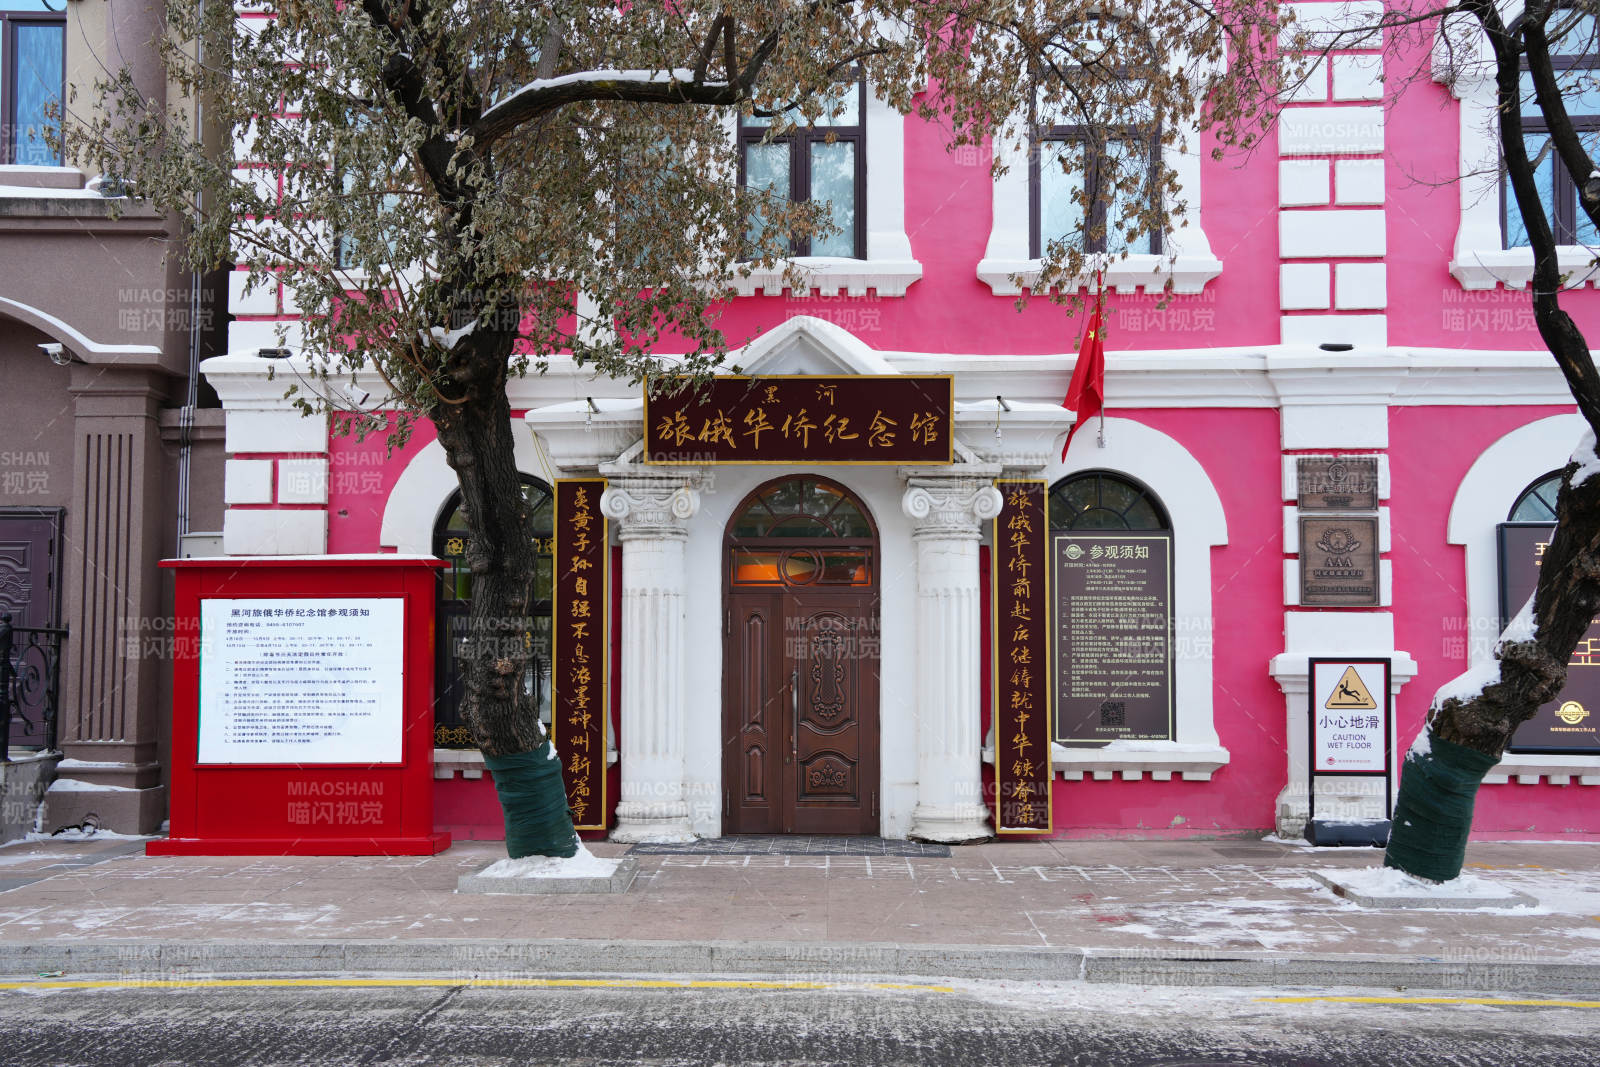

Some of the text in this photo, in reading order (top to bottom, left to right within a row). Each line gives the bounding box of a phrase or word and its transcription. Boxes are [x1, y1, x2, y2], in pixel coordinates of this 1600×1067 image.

[761, 384, 838, 406] 黑河
[656, 407, 940, 450] 旅俄华侨纪念馆
[1090, 545, 1149, 559] 参观须知
[1325, 557, 1353, 567] AAA
[231, 608, 370, 618] 黑河旅俄华侨纪念馆参观须知
[568, 486, 594, 823] 炎黄子孙自强不息浓墨神州新篇章
[1008, 488, 1035, 824] 旅俄华侨前赴后继铸就中华铁脊梁
[1319, 715, 1380, 729] 小心地滑
